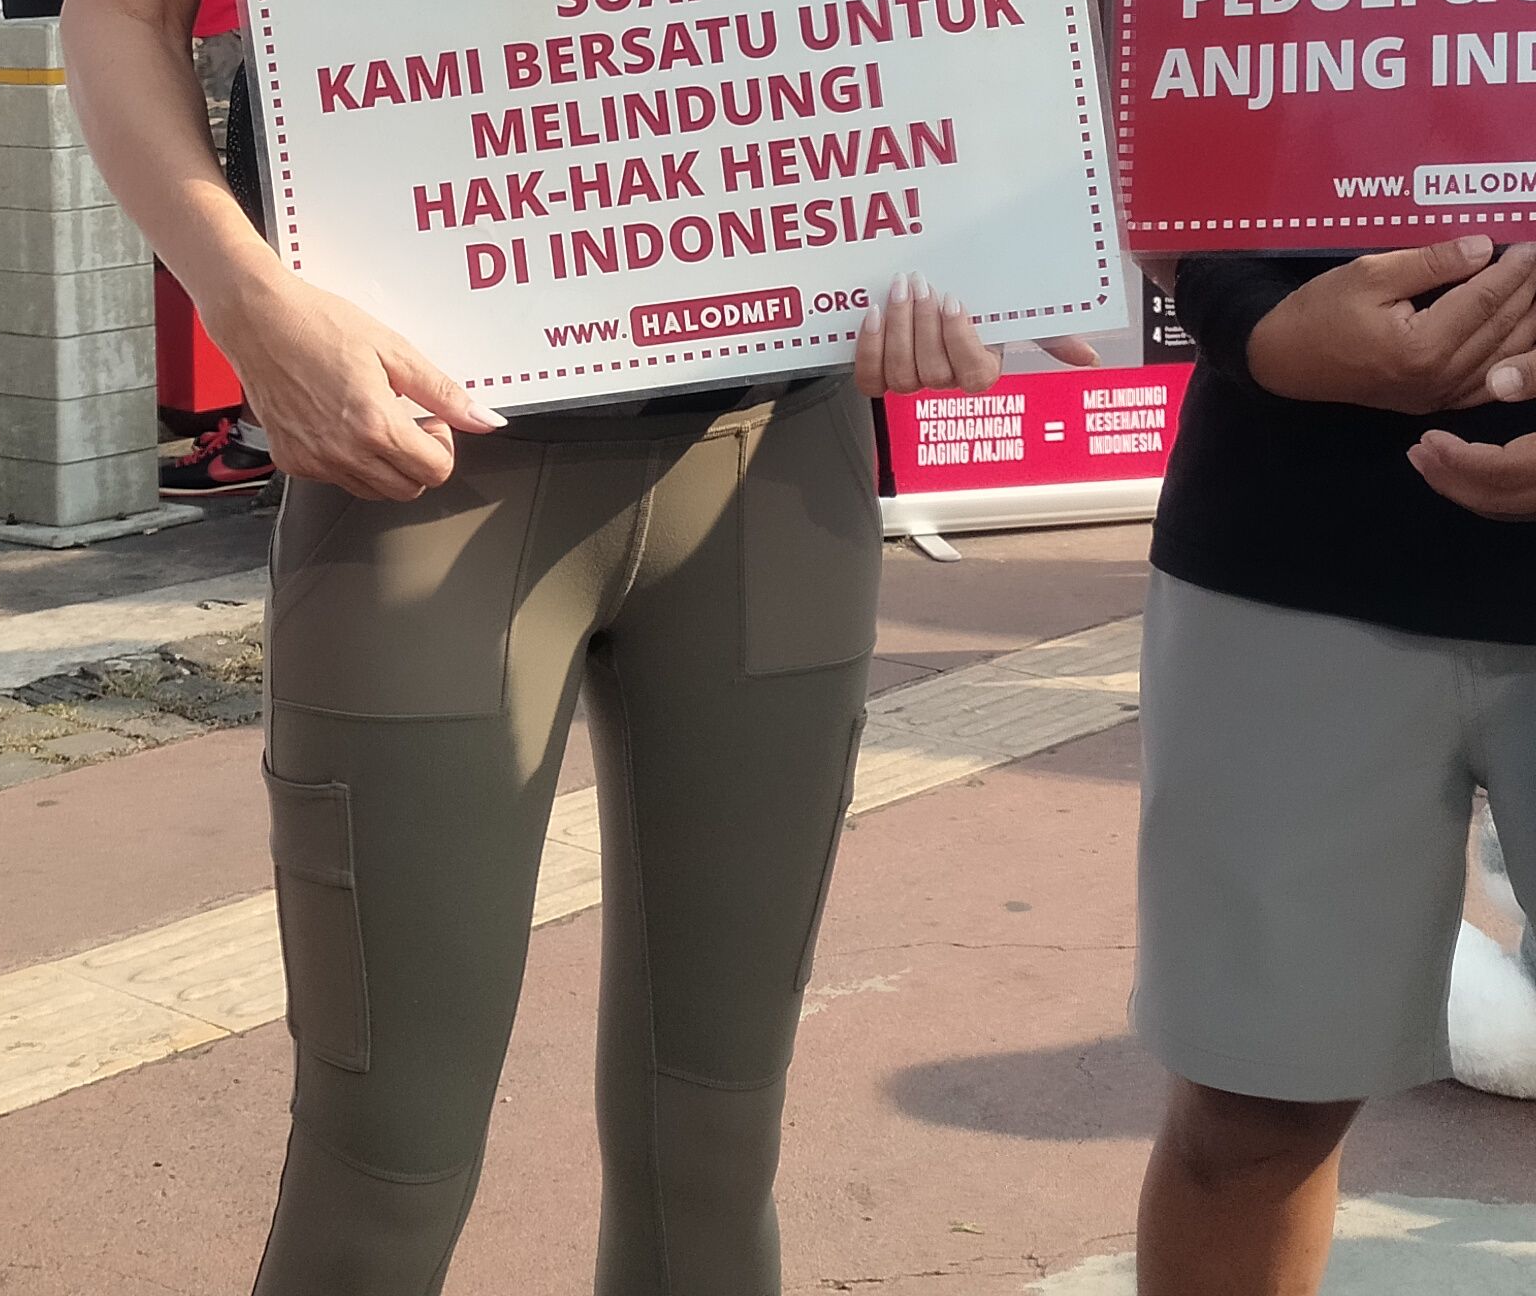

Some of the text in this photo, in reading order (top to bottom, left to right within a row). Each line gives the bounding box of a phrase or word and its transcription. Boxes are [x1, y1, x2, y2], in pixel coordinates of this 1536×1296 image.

[316, 46, 484, 114] KAMI
[502, 12, 778, 92] BERSATU
[1151, 36, 1406, 111] ANJING
[470, 61, 884, 160] MELINDUNGI
[411, 117, 959, 232] HAK-HAK HEWAN
[464, 187, 924, 291] DI INDONESIA!
[1152, 296, 1162, 314] 3
[1152, 326, 1162, 344] 4
[916, 394, 1026, 420] MENGHENTIKAN
[1082, 385, 1168, 410] MELINDUNGI
[919, 416, 1022, 442] PERDAGANGAN
[1086, 408, 1166, 433] KESEHATAN
[918, 438, 1024, 467] DAGING ANJING
[1088, 432, 1163, 456] INDONESIA
